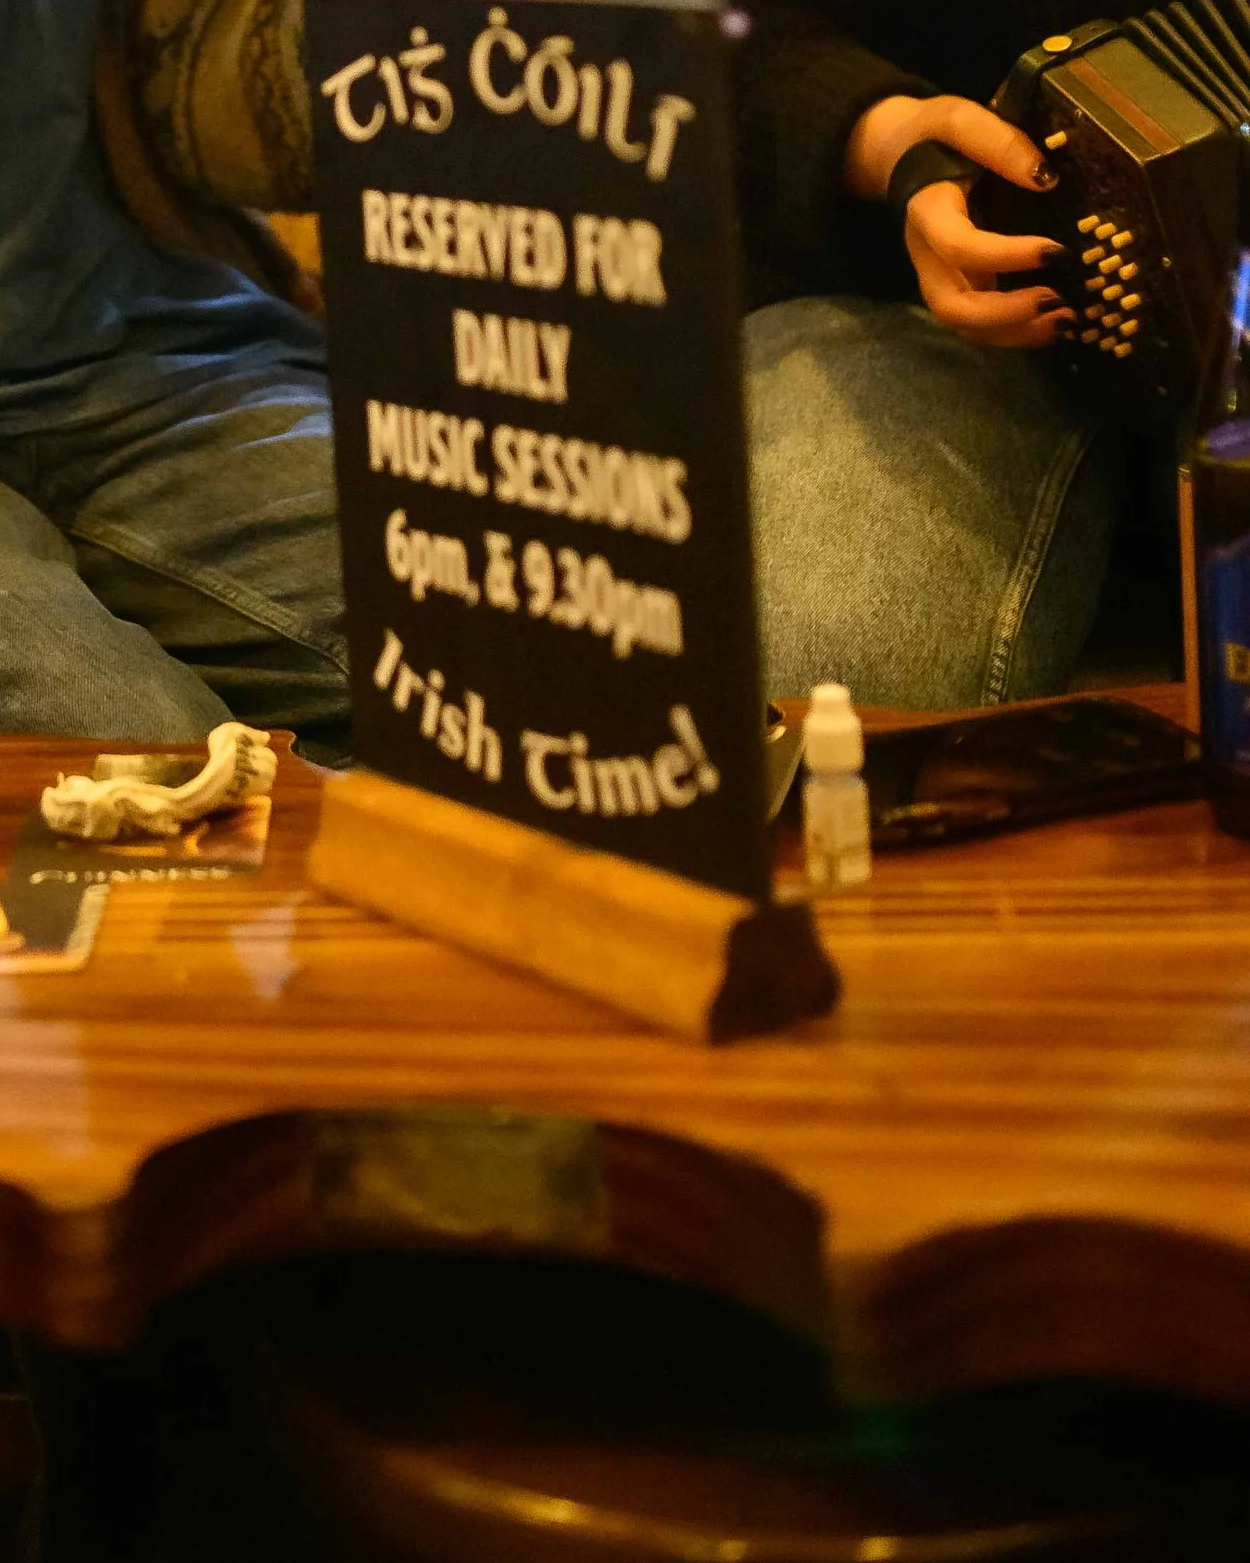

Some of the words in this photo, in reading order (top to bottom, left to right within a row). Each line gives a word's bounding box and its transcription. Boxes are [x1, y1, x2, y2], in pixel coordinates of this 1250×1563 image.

[361, 189, 568, 290] RESERVED
[572, 213, 667, 307] FOR
[451, 309, 571, 404] DAILY
[365, 399, 488, 497] MUSIC
[491, 424, 692, 544] SESSIONS
[373, 628, 503, 783] Irish
[520, 703, 721, 817] Time!
